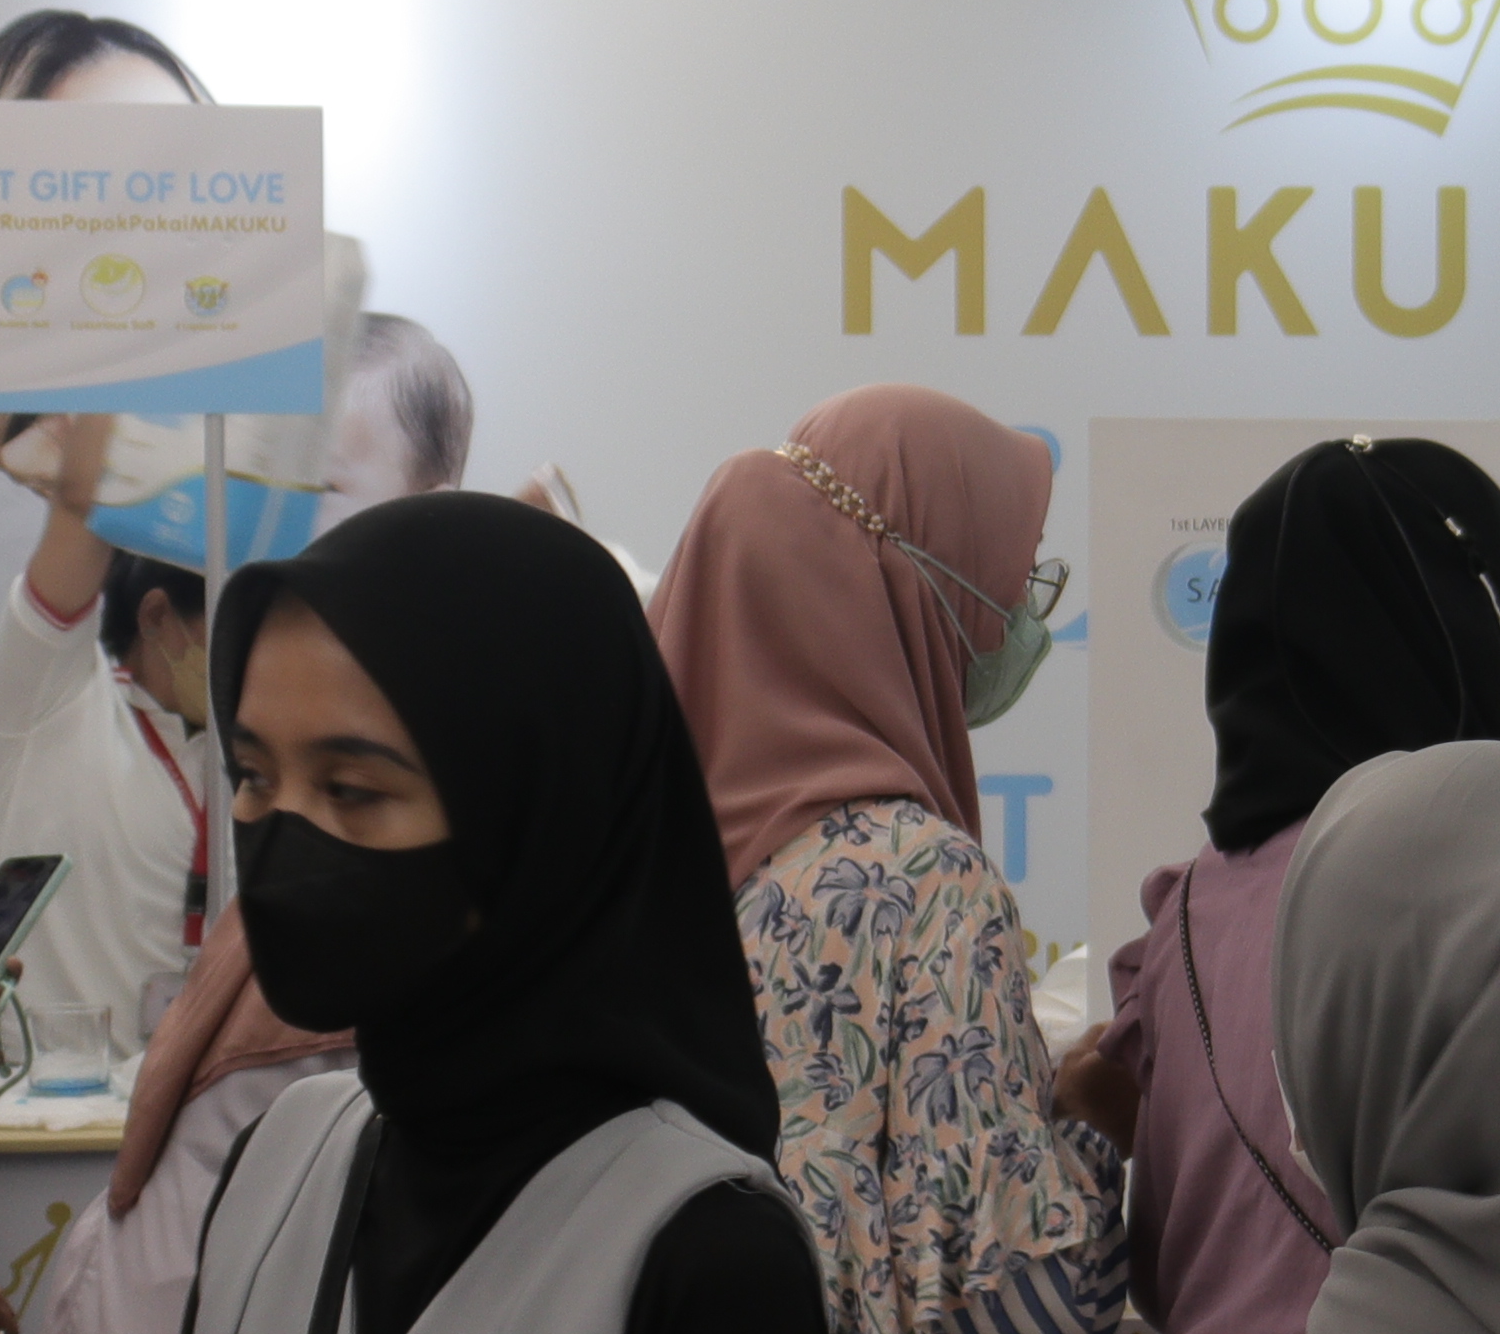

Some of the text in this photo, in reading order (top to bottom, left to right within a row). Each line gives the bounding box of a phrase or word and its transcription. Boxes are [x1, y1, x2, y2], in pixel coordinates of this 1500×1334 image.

[29, 169, 111, 203] GIFT
[125, 170, 177, 204] OF
[190, 171, 286, 205] LOVE
